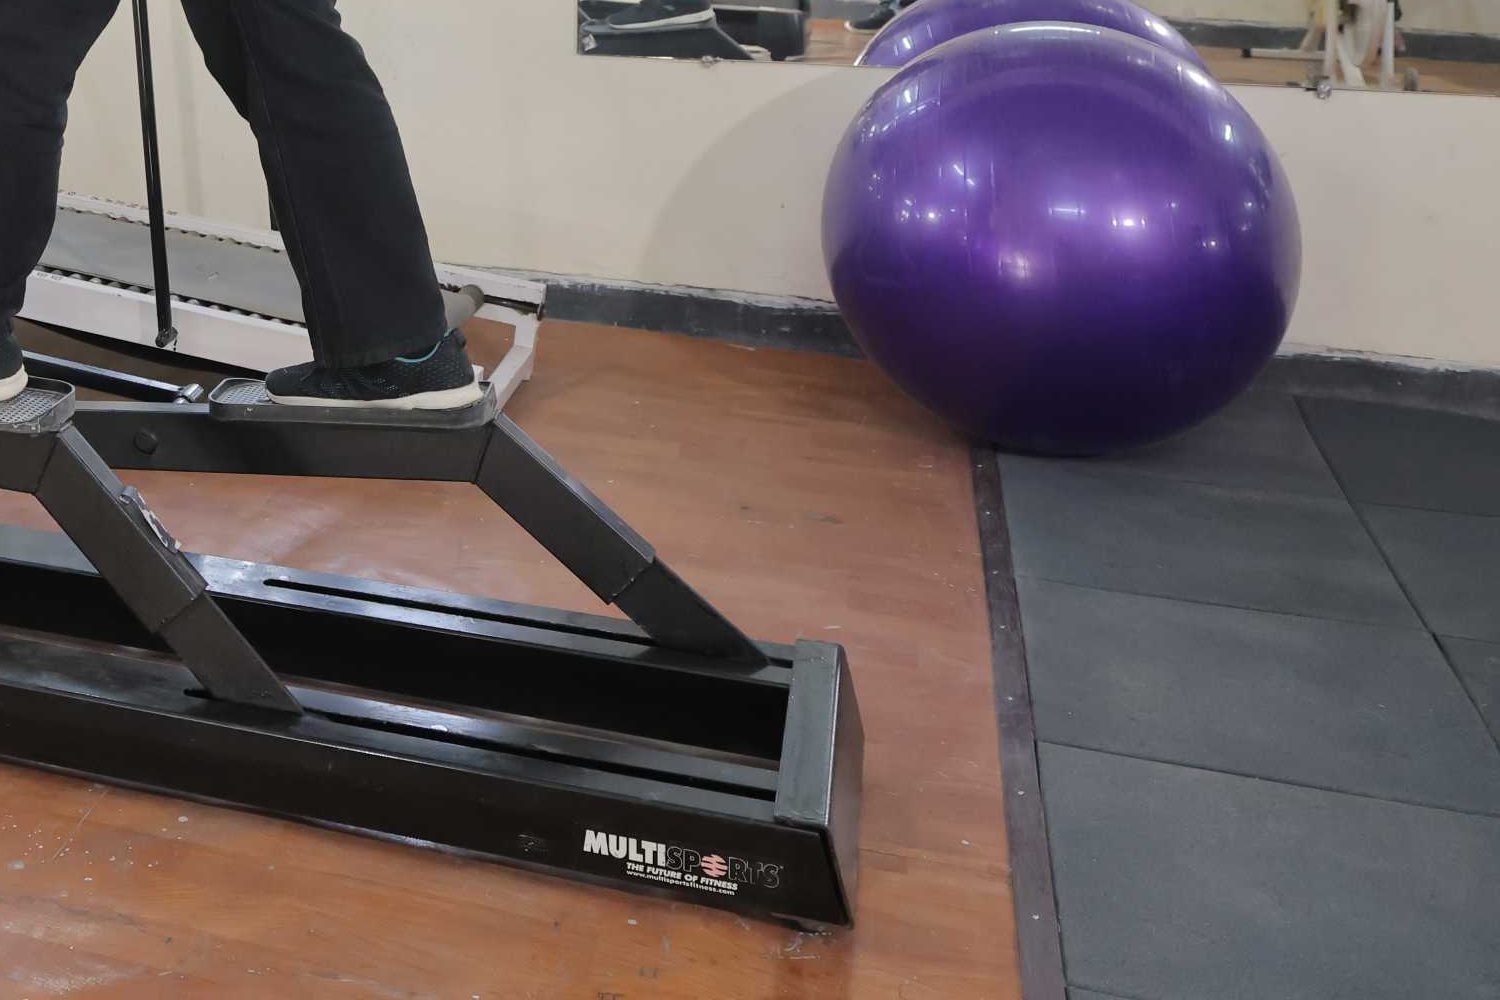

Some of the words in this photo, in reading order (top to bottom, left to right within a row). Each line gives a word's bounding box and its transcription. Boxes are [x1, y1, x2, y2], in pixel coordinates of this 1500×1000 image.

[626, 862, 645, 872] THE
[646, 865, 682, 880] FUTURE
[684, 872, 698, 882] OF
[700, 877, 739, 891] FITNESS
